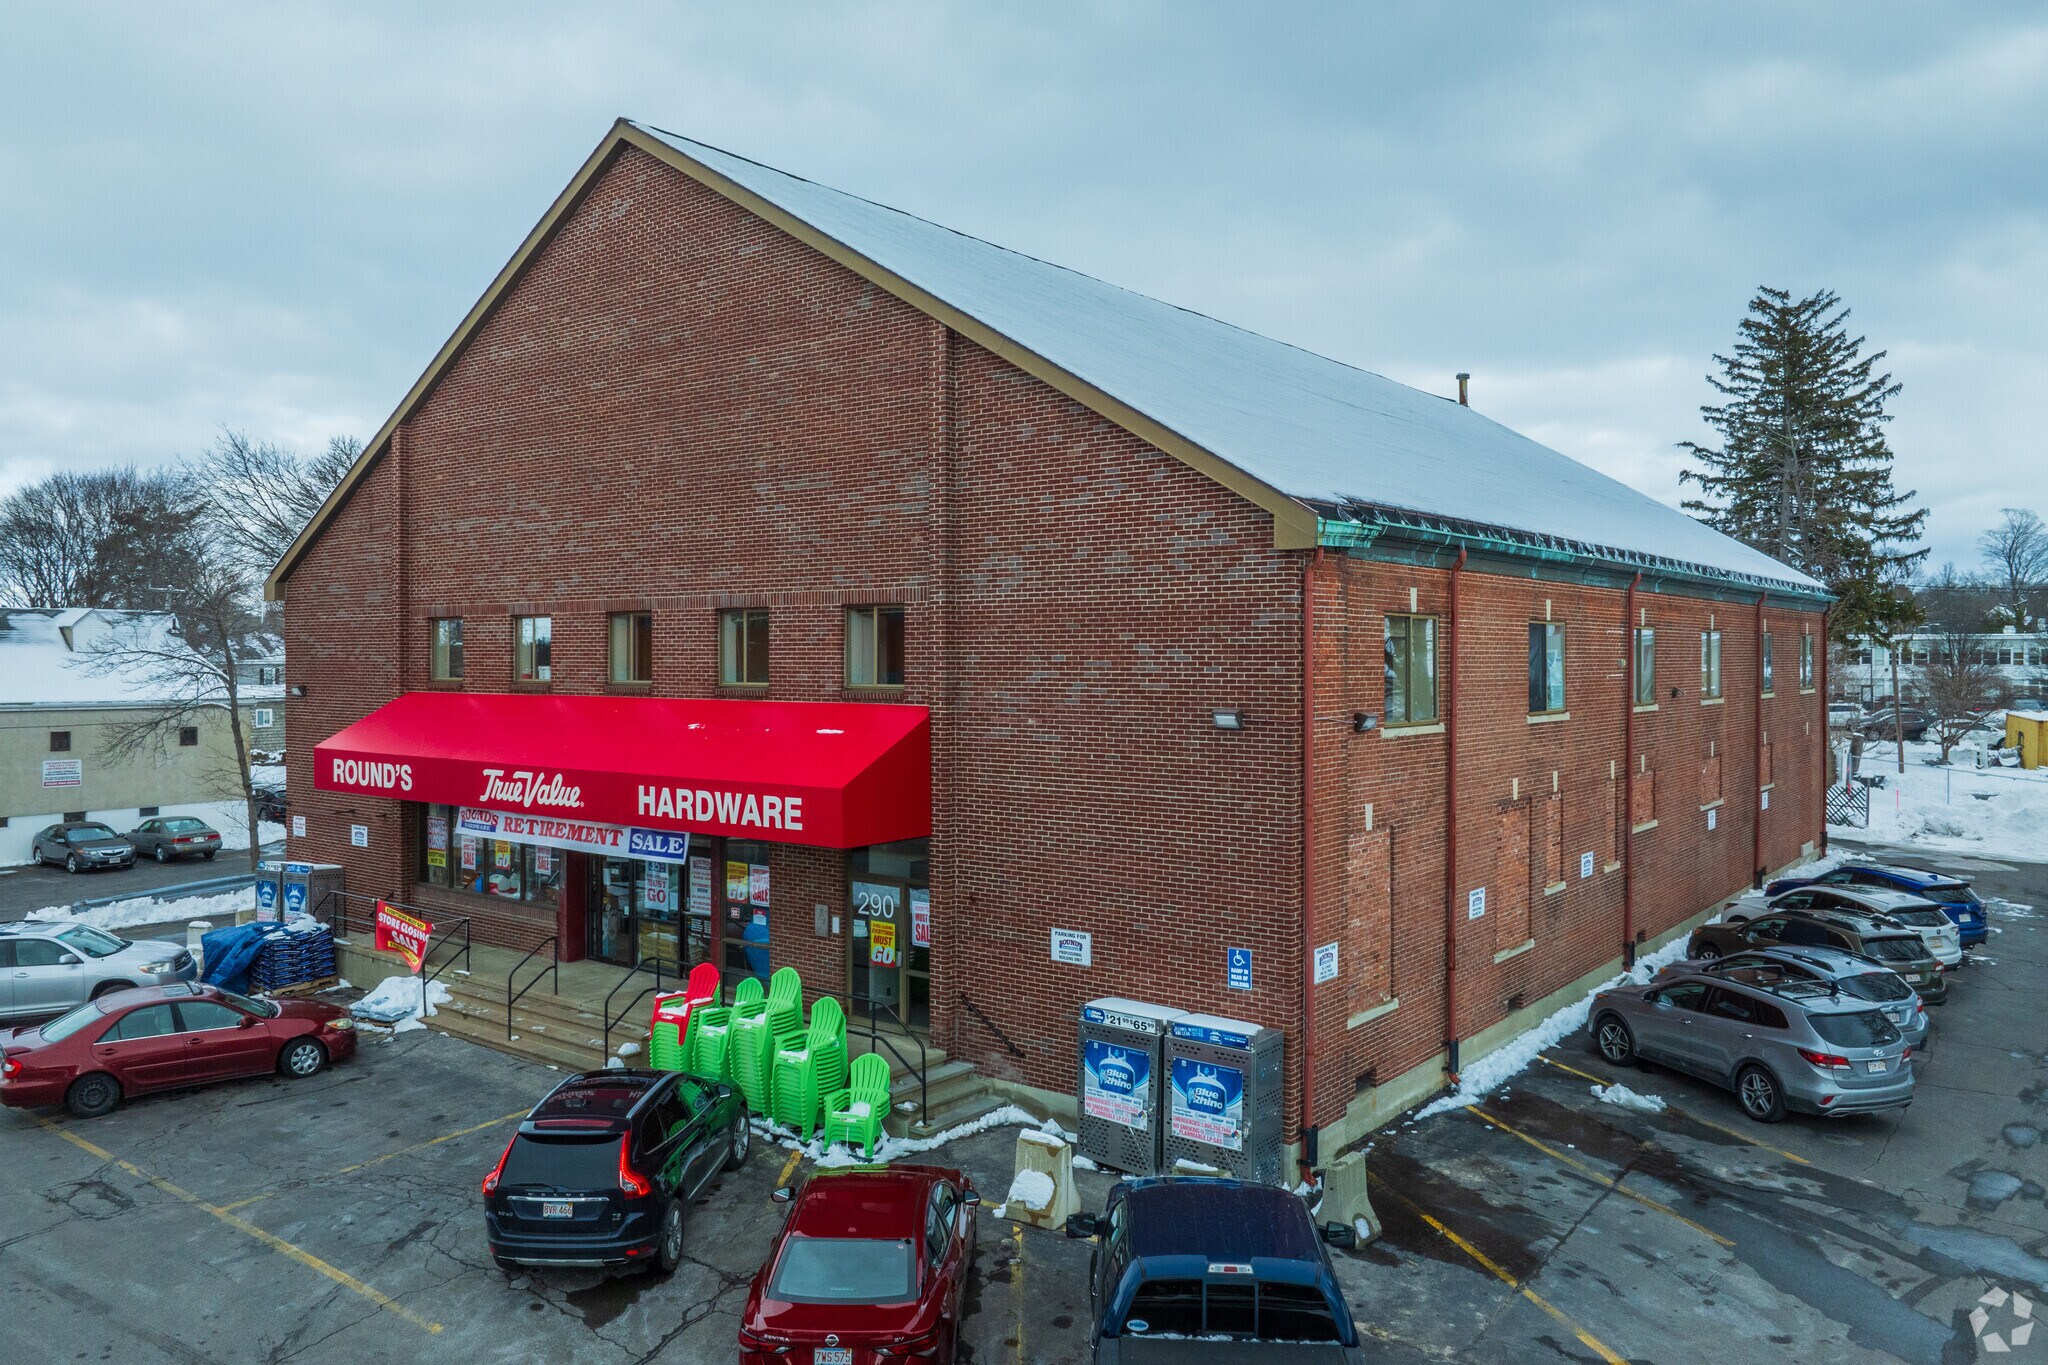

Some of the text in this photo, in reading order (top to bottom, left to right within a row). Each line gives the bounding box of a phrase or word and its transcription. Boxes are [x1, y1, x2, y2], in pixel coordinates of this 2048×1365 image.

[333, 758, 412, 791] ROUND'S
[638, 785, 803, 831] HARDWARE
[461, 809, 498, 827] ROUND'S
[503, 817, 624, 847] RETIREMENT
[631, 833, 684, 855] SALE
[463, 851, 475, 866] SALE
[496, 854, 510, 867] GO
[647, 888, 667, 903] GO
[727, 884, 747, 900] GO
[858, 892, 894, 918] 290
[915, 912, 928, 922] MUST
[378, 912, 430, 942] STORE CLOSING
[915, 923, 930, 942] SAL
[391, 930, 419, 954] SALE
[874, 935, 892, 946] MUST
[872, 945, 894, 964] GO
[1106, 1069, 1128, 1080] Blue
[1104, 1077, 1132, 1090] Rhino
[1195, 1087, 1219, 1099] Blue
[1193, 1096, 1223, 1110] Rhino
[559, 1205, 572, 1215] 466
[763, 1334, 790, 1342] SENTRA
[816, 1351, 850, 1362] 7WS 575
